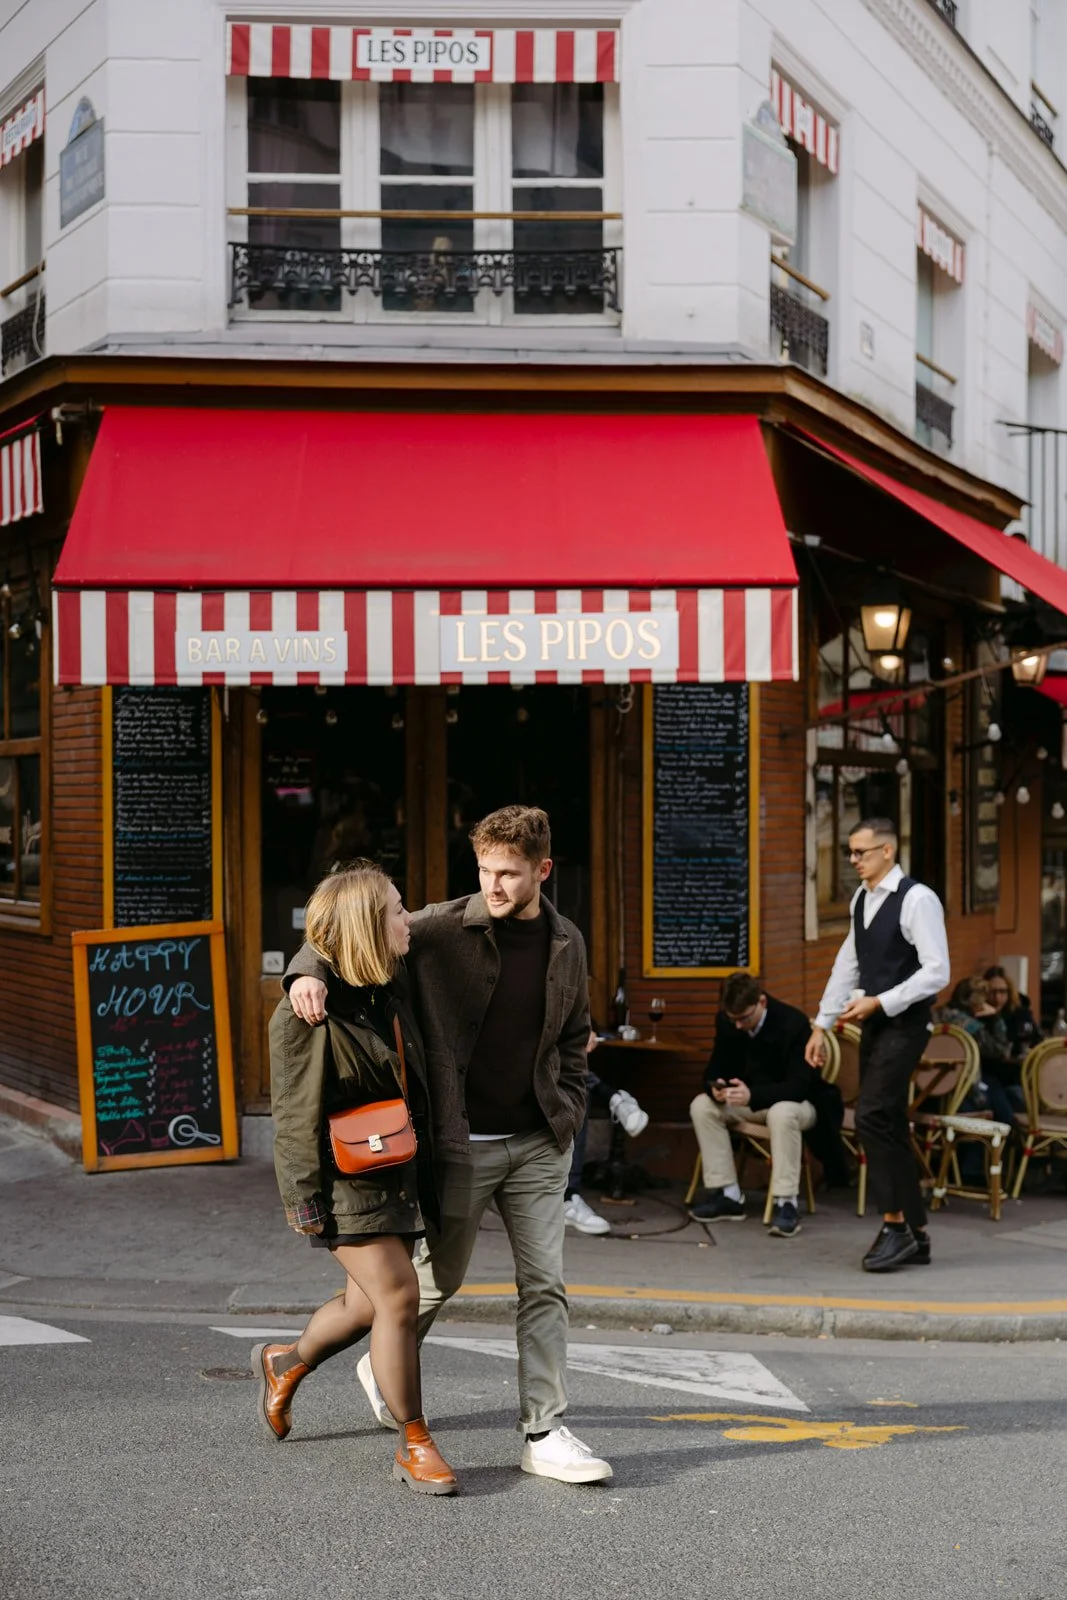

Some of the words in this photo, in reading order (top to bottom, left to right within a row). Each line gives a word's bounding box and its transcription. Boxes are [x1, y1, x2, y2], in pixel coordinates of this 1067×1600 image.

[368, 39, 406, 63] LES
[413, 40, 479, 64] PIPOS
[187, 637, 241, 664] BAR
[250, 637, 267, 664] A
[274, 637, 337, 664] VINS
[456, 620, 528, 662] LES
[539, 618, 662, 661] PIPOS
[89, 938, 202, 972] HAPPY
[97, 981, 211, 1017] HOUR
